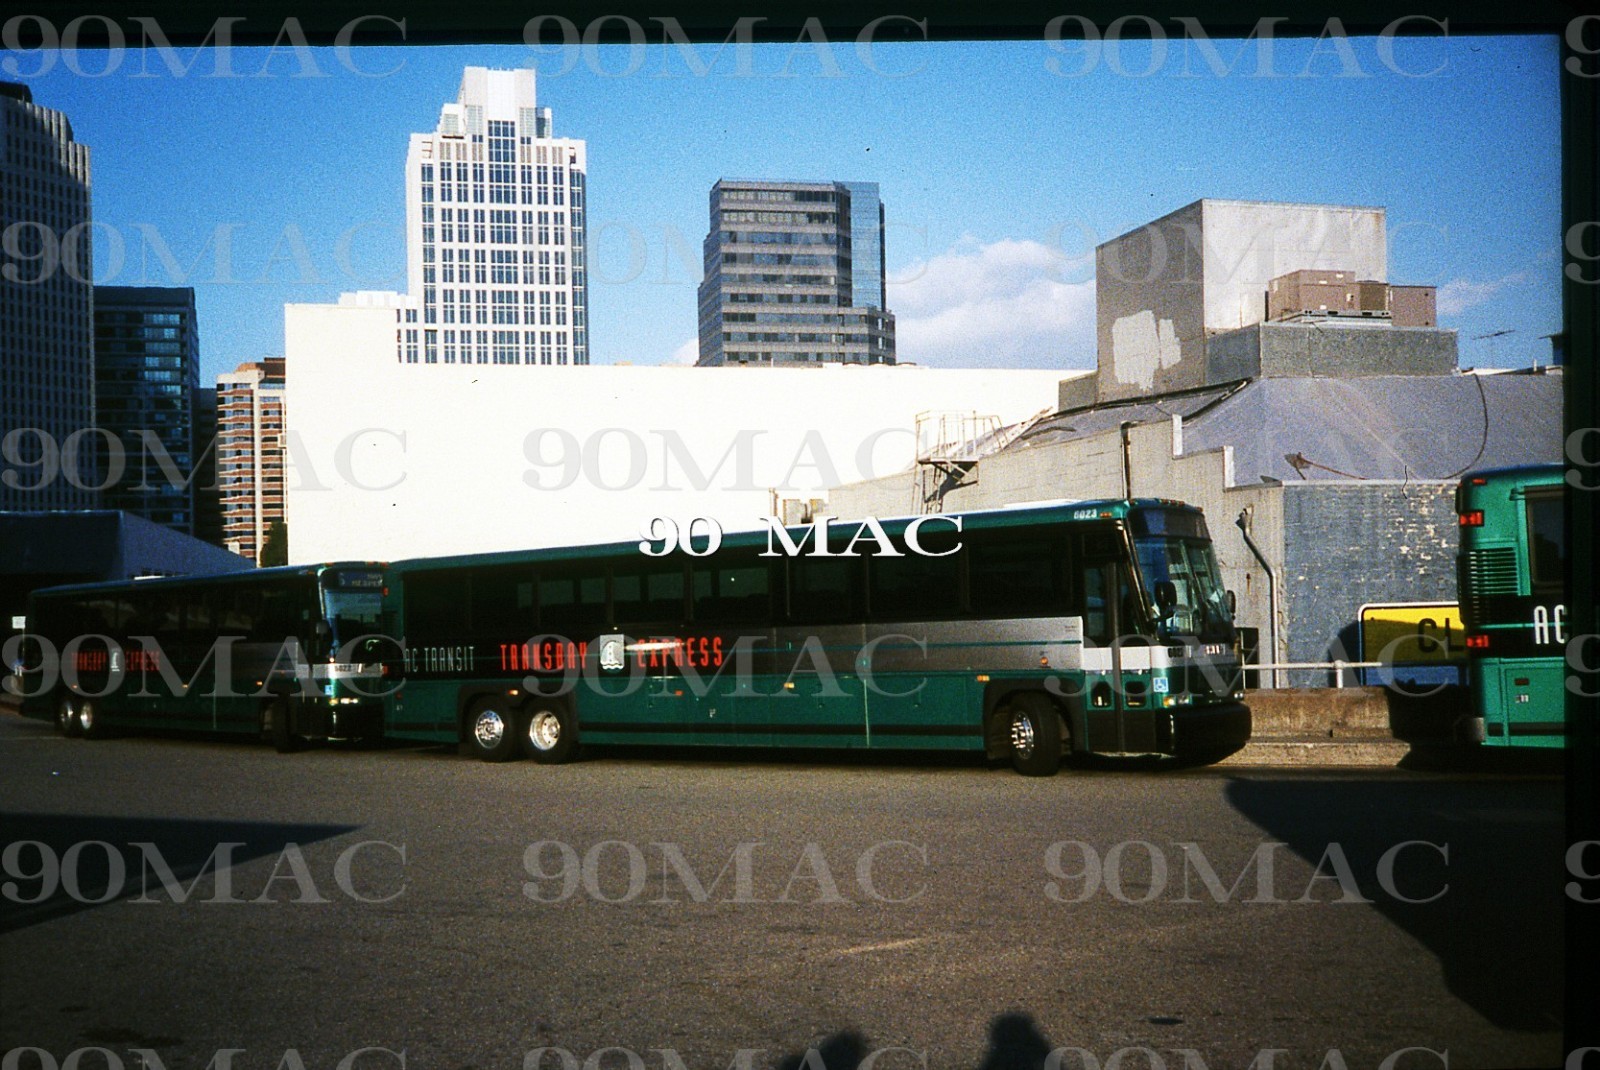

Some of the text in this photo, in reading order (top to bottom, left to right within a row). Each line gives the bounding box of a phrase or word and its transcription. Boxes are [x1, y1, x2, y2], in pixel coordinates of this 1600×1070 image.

[1534, 604, 1567, 644] AC
[404, 646, 474, 672] AC TRANSIT
[500, 637, 722, 671] TRANSBAY EXPRESS
